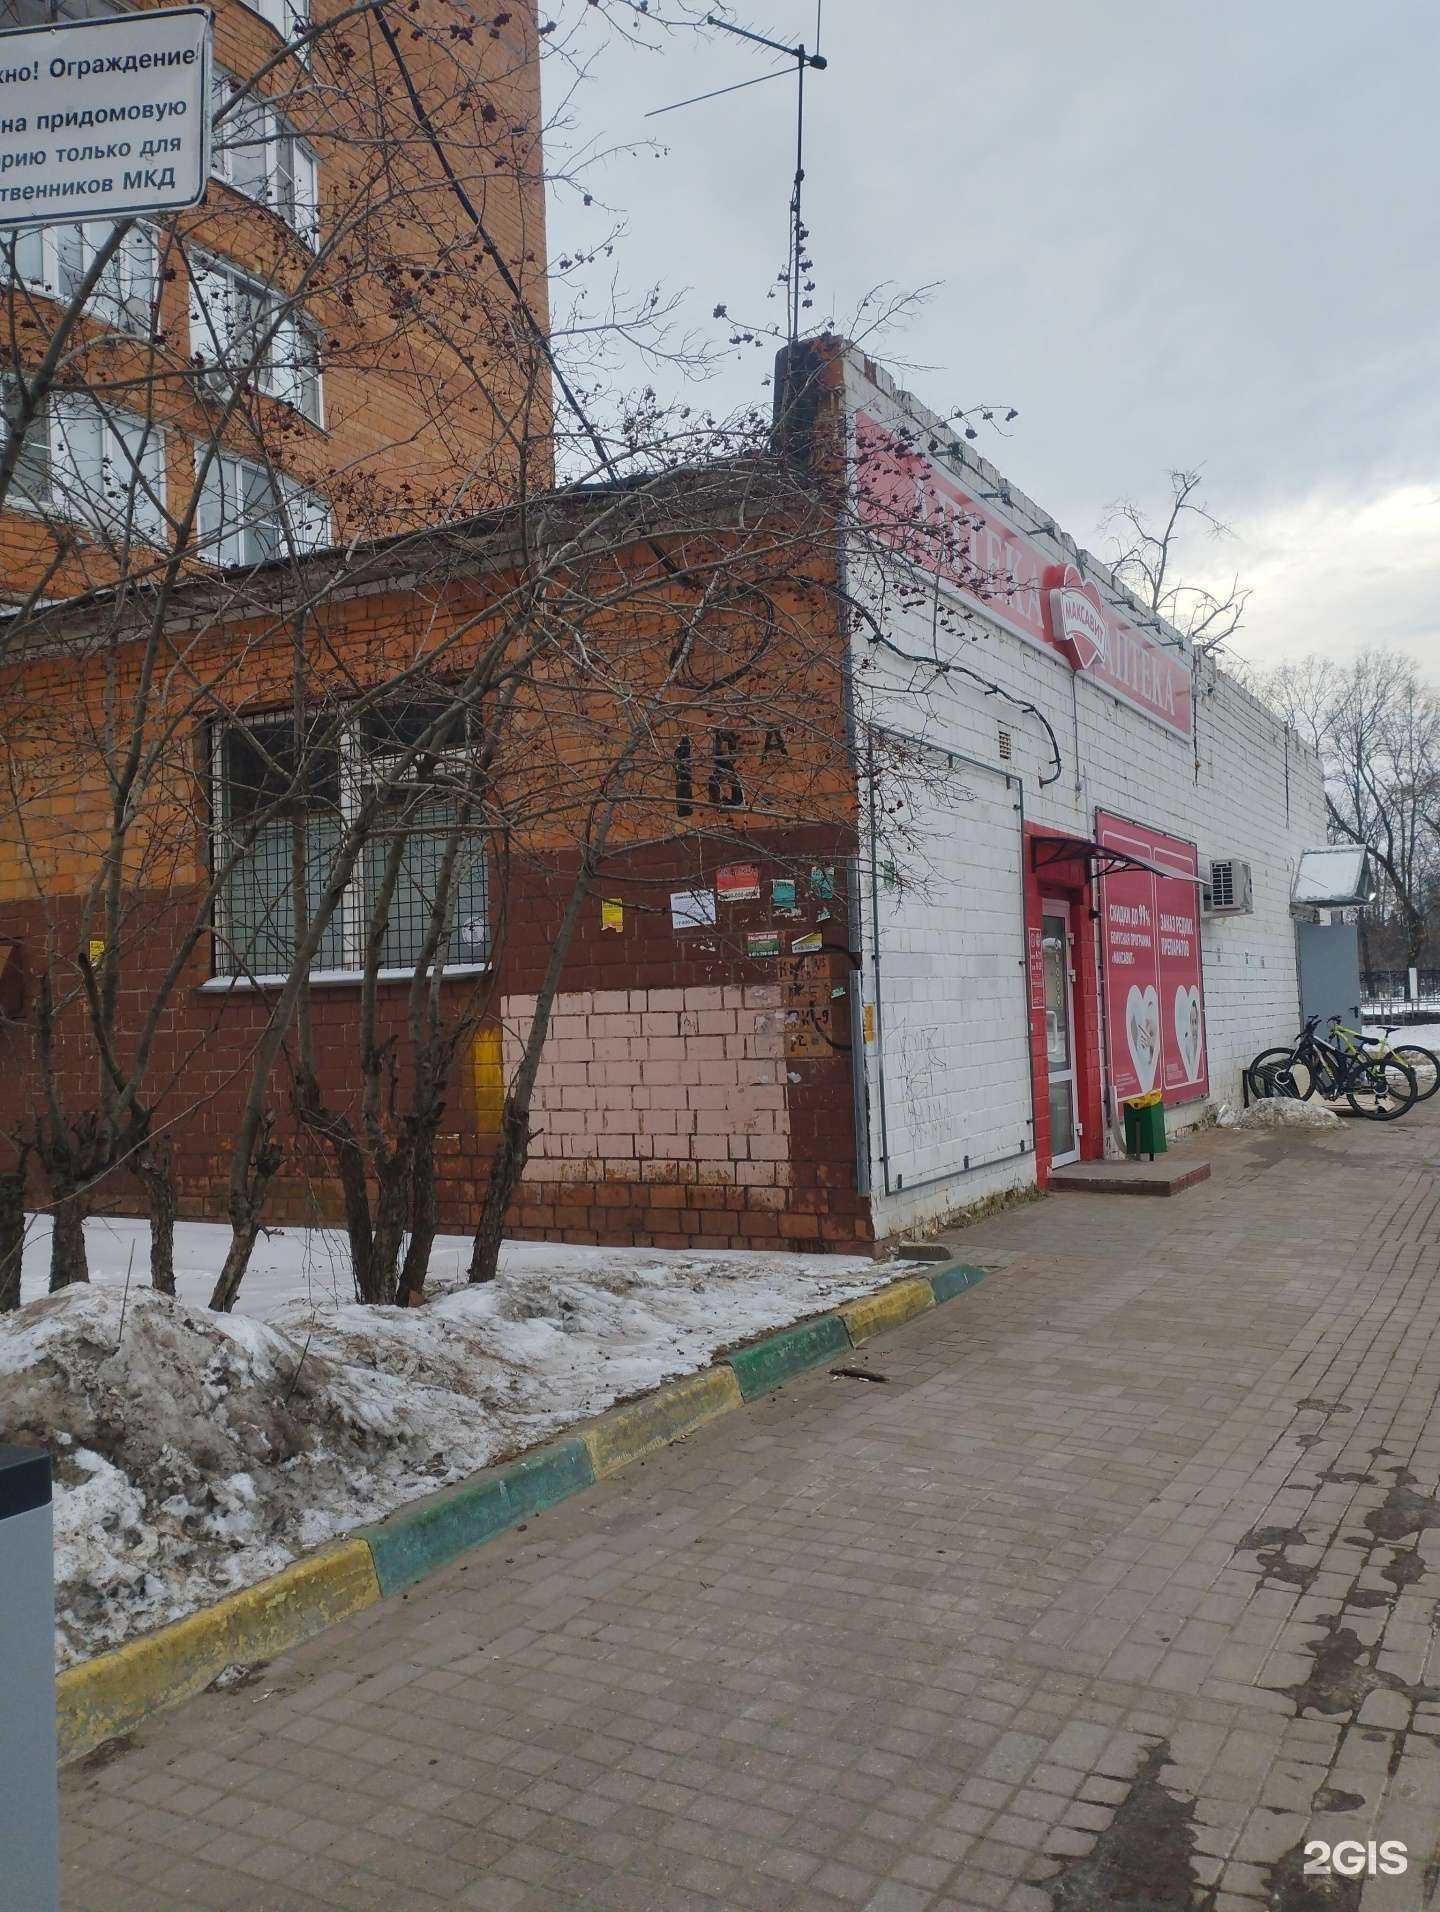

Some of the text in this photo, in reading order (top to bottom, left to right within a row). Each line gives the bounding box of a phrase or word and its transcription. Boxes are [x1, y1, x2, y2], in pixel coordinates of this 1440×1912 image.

[49, 48, 195, 79] Ограждение
[36, 100, 187, 132] придомовую
[55, 142, 131, 163] только
[139, 137, 182, 158] для
[122, 167, 176, 191] МКД
[1065, 602, 1104, 644] МАКСАВИТ
